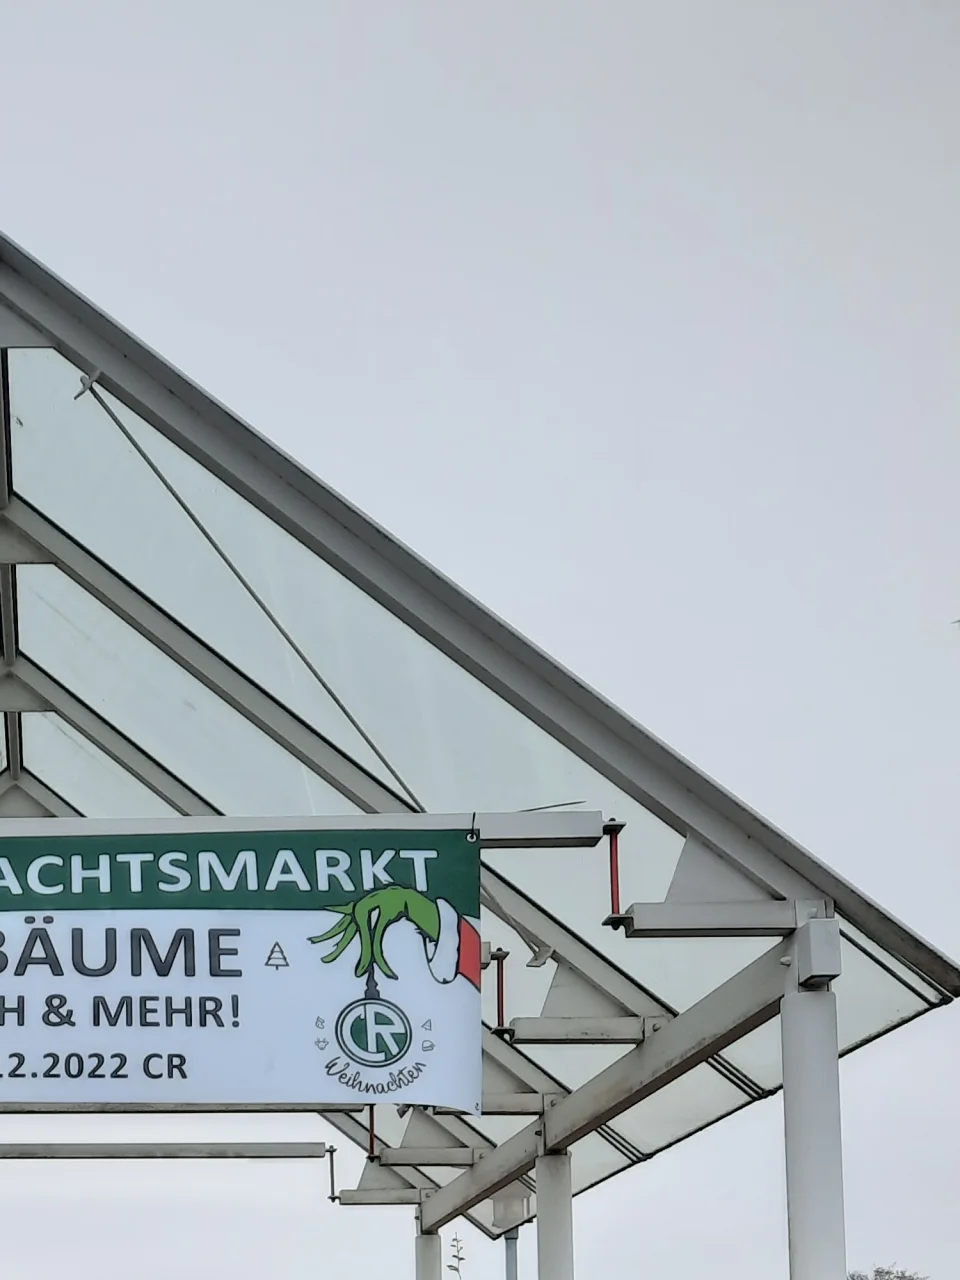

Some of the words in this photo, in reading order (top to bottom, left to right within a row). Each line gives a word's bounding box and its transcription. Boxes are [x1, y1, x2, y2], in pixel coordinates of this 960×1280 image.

[42, 993, 76, 1027] &
[92, 993, 240, 1027] MEHR!
[142, 1052, 188, 1080] CR
[324, 1056, 427, 1095] Weihnachten
